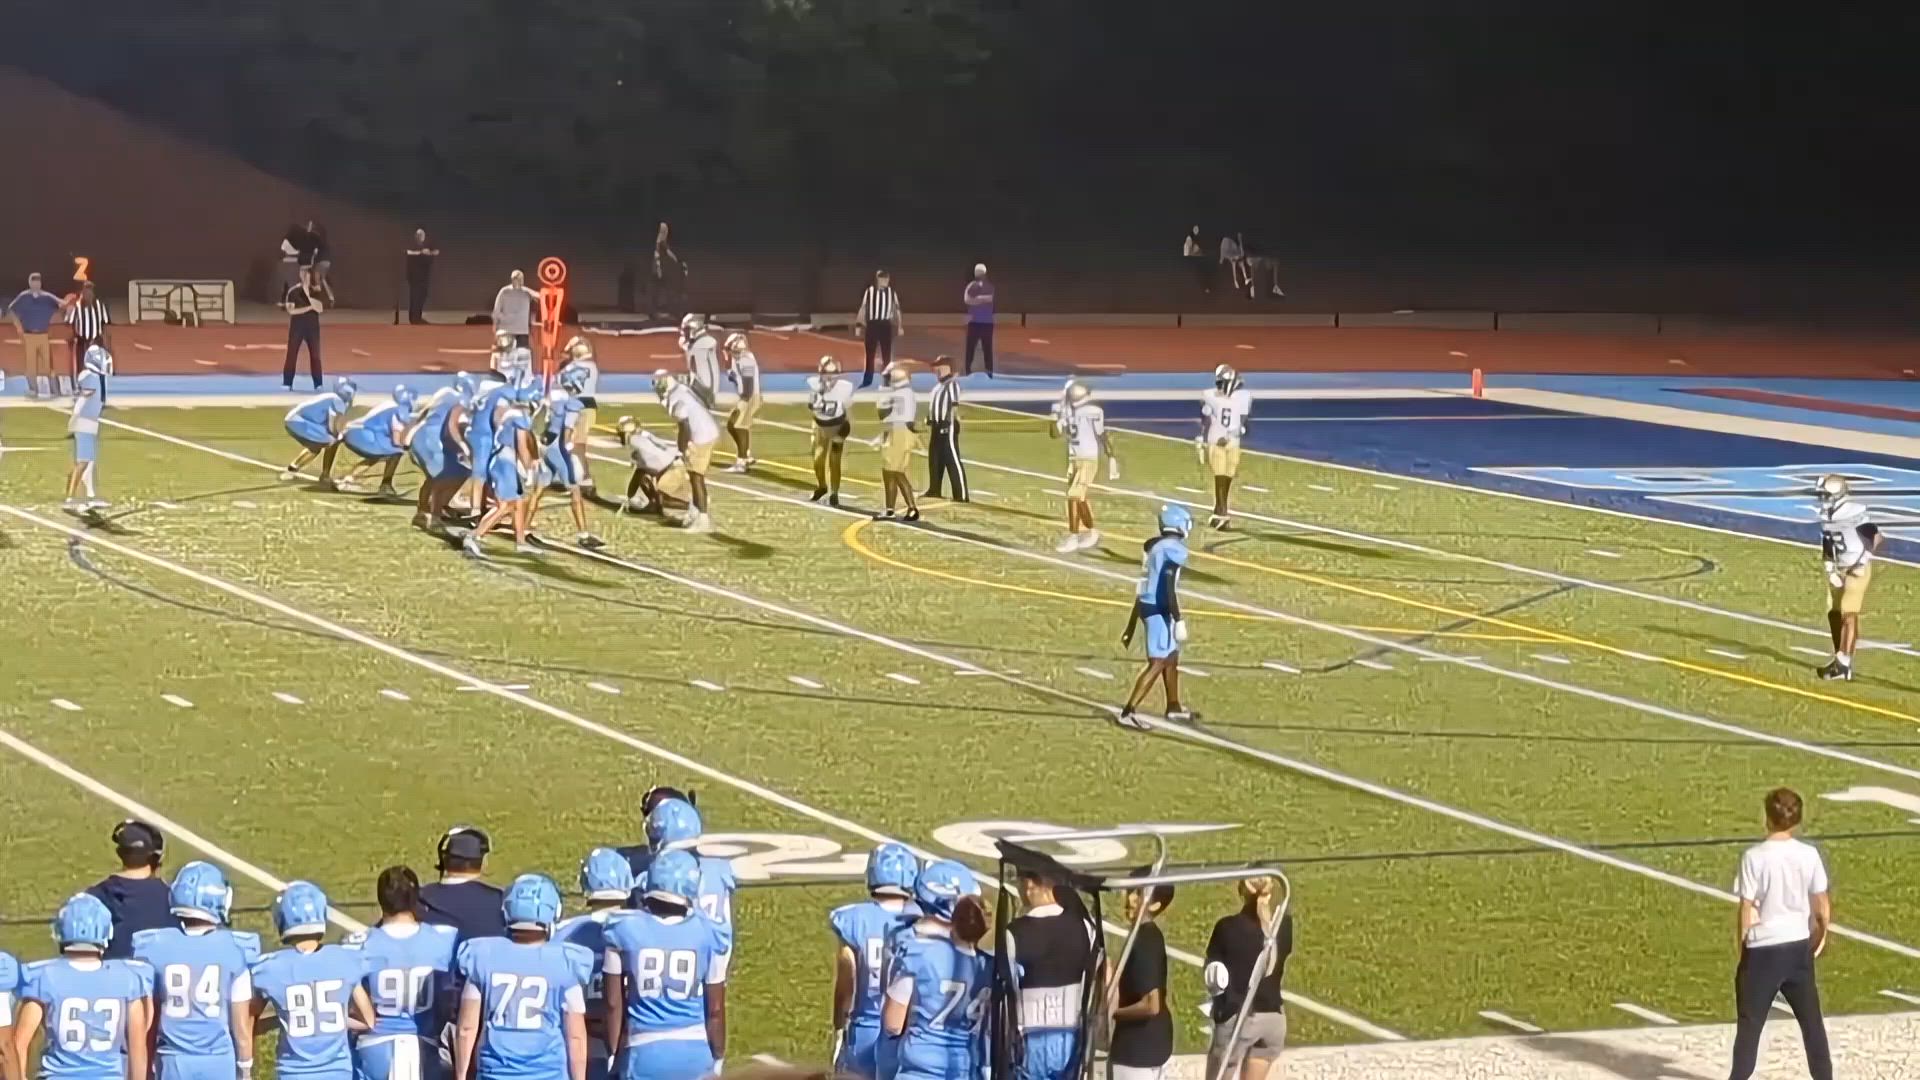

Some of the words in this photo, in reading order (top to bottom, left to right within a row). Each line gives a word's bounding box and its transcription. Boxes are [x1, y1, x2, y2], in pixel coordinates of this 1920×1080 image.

[73, 256, 89, 280] 2
[1221, 407, 1232, 428] 6
[164, 964, 220, 1018] 84
[377, 966, 434, 1017] 90
[637, 948, 696, 1000] 89
[58, 998, 121, 1051] 63
[285, 979, 344, 1037] 85
[491, 973, 548, 1029] 72
